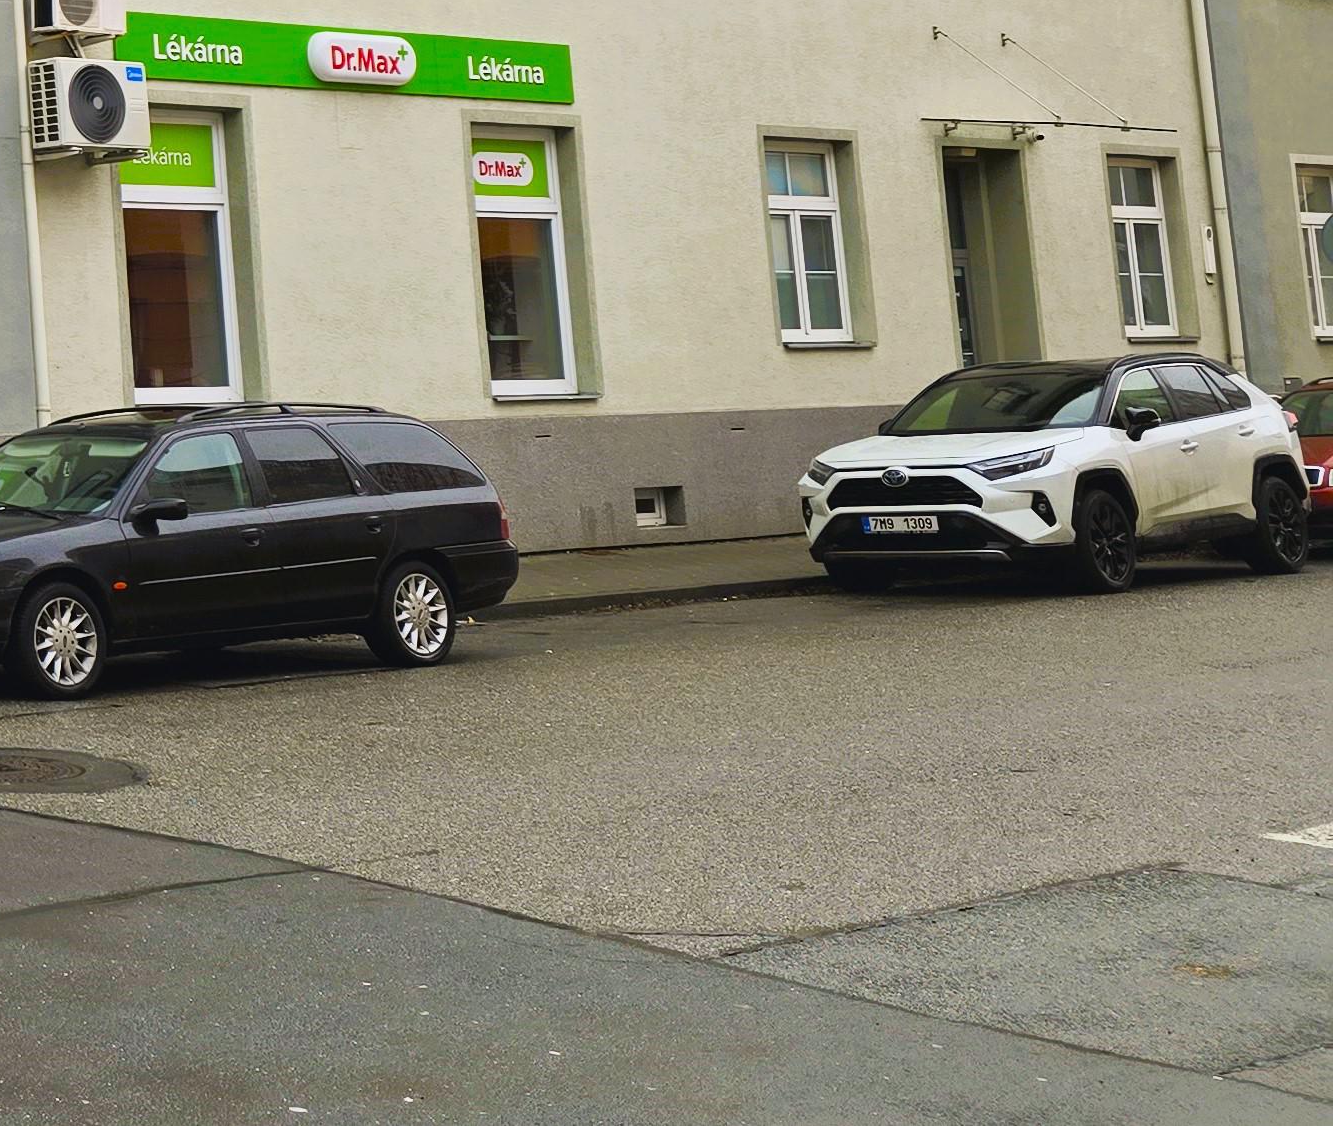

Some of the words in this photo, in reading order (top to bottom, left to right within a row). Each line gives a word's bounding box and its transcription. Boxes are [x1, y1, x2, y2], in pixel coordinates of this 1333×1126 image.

[153, 33, 243, 65] Lékárna
[331, 45, 401, 75] Dr.Max
[467, 55, 545, 85] Lékárna
[479, 160, 522, 178] Dr.Max
[872, 518, 894, 529] 7M9
[903, 517, 932, 529] 1309
